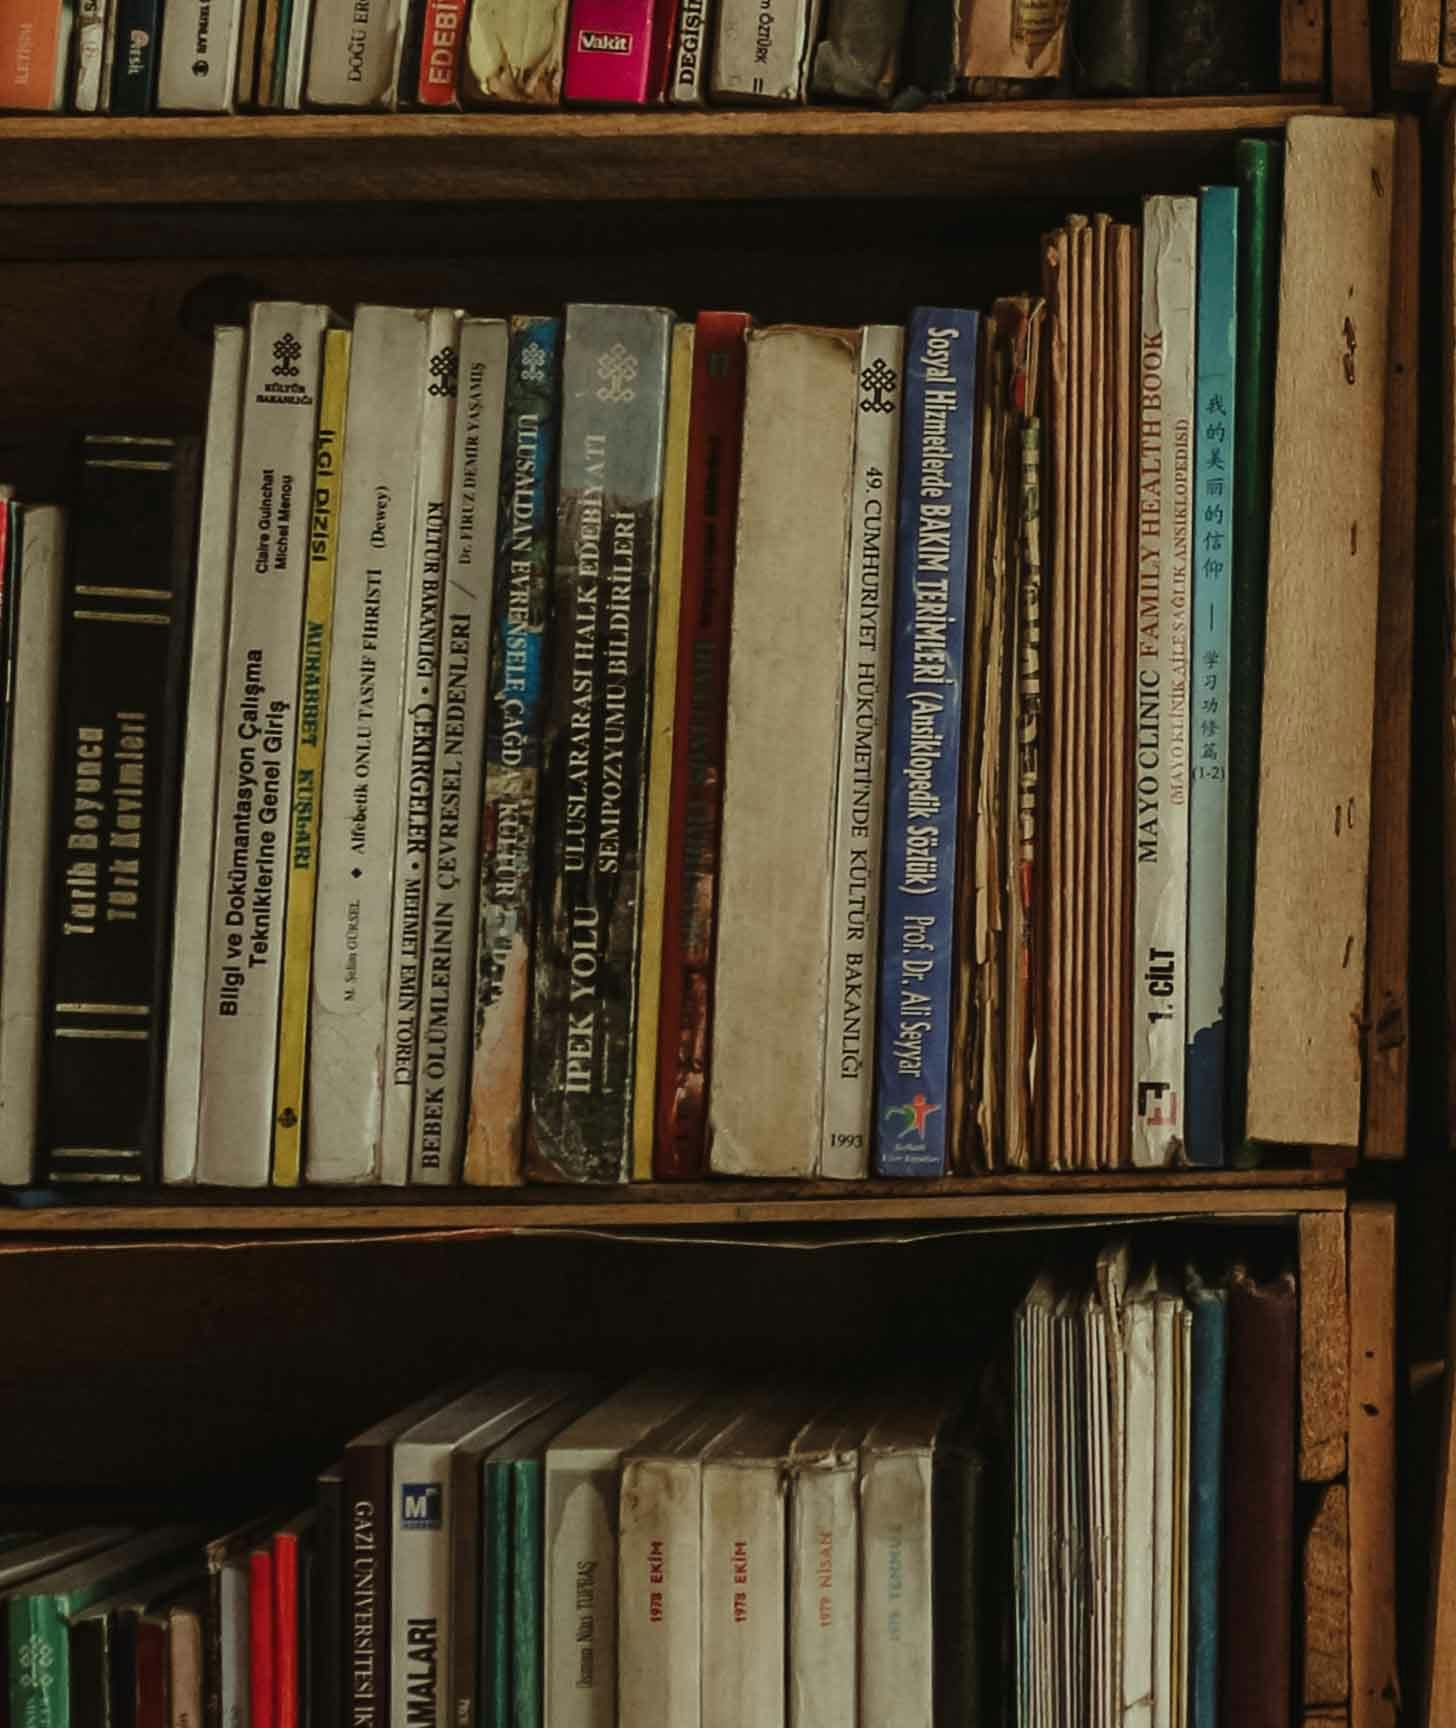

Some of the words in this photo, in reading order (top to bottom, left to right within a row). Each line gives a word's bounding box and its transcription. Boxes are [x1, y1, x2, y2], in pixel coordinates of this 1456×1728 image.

[920, 328, 959, 383] Sosyal
[1140, 331, 1164, 410] BOOK
[1140, 419, 1162, 535] HEALTH
[856, 499, 884, 649] CUMHURİYET
[915, 504, 952, 570] BAKIM
[573, 586, 597, 660] HALK
[911, 579, 953, 683] TERİMLERİ
[1139, 546, 1161, 659] FAMILY
[240, 649, 267, 740] Çalışma
[441, 613, 472, 755] NEDENLERİ
[1137, 670, 1161, 769] CLINIC
[564, 670, 595, 873] ULUSLARARASI
[600, 684, 629, 873] SEMPOZYUMU
[1137, 777, 1160, 864] MAYO
[224, 746, 261, 927] Dokümantasyon
[247, 830, 277, 968] Tekniklerine
[262, 700, 289, 751] Giriş
[435, 756, 466, 889] ÇEVRESEL
[220, 962, 249, 1016] Bilgi
[570, 906, 600, 1002] YOLU
[1143, 948, 1175, 997] CİLT
[564, 1013, 595, 1094] İPEK
[840, 952, 867, 1078] BAKANLIĞI
[420, 1088, 446, 1169] BEBEK
